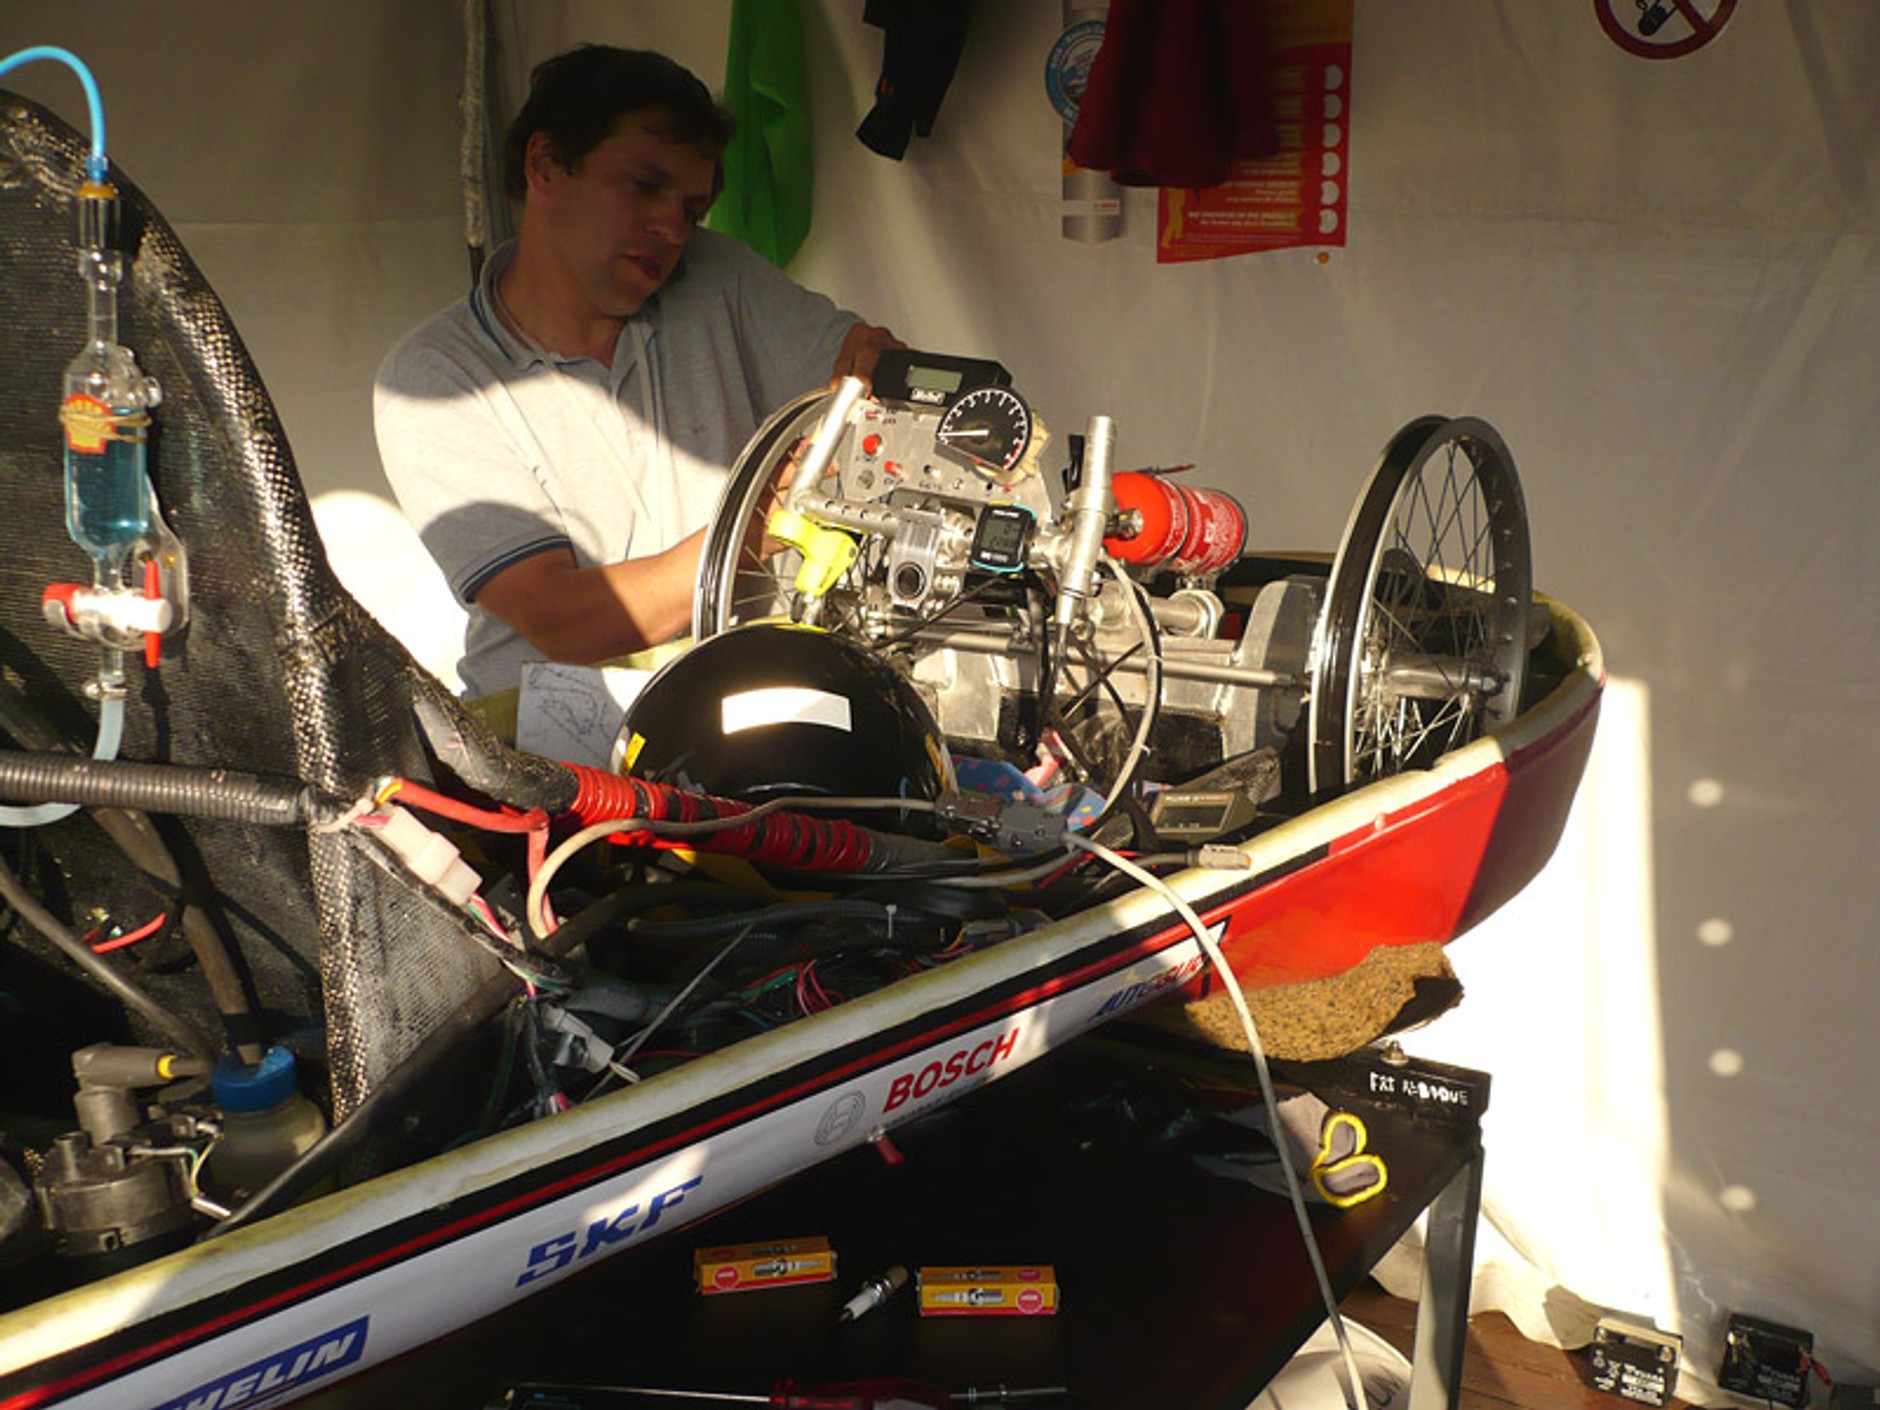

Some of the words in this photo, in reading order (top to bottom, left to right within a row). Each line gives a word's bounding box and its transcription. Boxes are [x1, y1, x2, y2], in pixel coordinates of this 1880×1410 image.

[884, 1029, 1020, 1113] BOSCH
[516, 1177, 701, 1289] SKF
[172, 1331, 358, 1410] HELIN
